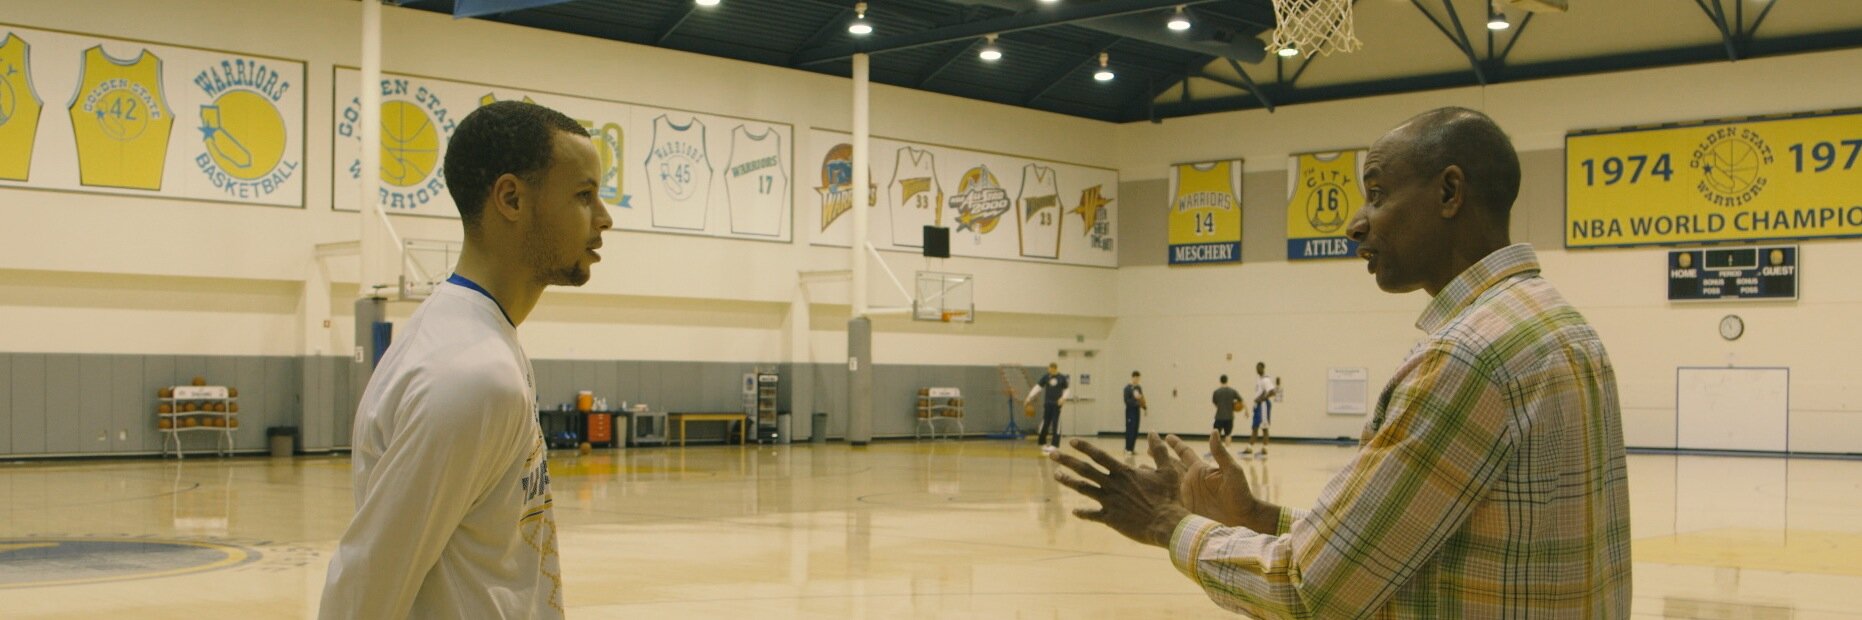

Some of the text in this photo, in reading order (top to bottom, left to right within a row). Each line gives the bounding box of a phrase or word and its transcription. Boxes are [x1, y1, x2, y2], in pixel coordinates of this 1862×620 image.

[194, 59, 290, 102] WARRIORS
[83, 79, 161, 119] GOLDEN STATE
[110, 98, 138, 121] 42
[654, 141, 705, 163] WARRIORS
[1690, 127, 1774, 169] GOLDEN STATE
[196, 152, 299, 199] BASKETBALL
[675, 163, 691, 184] 45
[731, 155, 778, 178] WARRIORS
[1581, 153, 1674, 187] 1974
[758, 175, 773, 195] 17
[1306, 171, 1351, 188] CITY
[916, 194, 929, 209] 33
[1178, 191, 1232, 212] WARRIORS
[1316, 188, 1339, 212] 16
[1696, 176, 1767, 207] WARRIORS
[971, 200, 1008, 213] 2000
[1195, 212, 1215, 234] 14
[1572, 219, 1623, 240] NBA
[1631, 213, 1725, 236] WORLD
[1175, 243, 1234, 261] MESCHERY
[1304, 238, 1349, 257] ATTLES
[1671, 268, 1698, 279] HOME
[1736, 277, 1758, 285] BONUS
[1763, 265, 1794, 276] GUEST
[1703, 278, 1725, 286] BONUS
